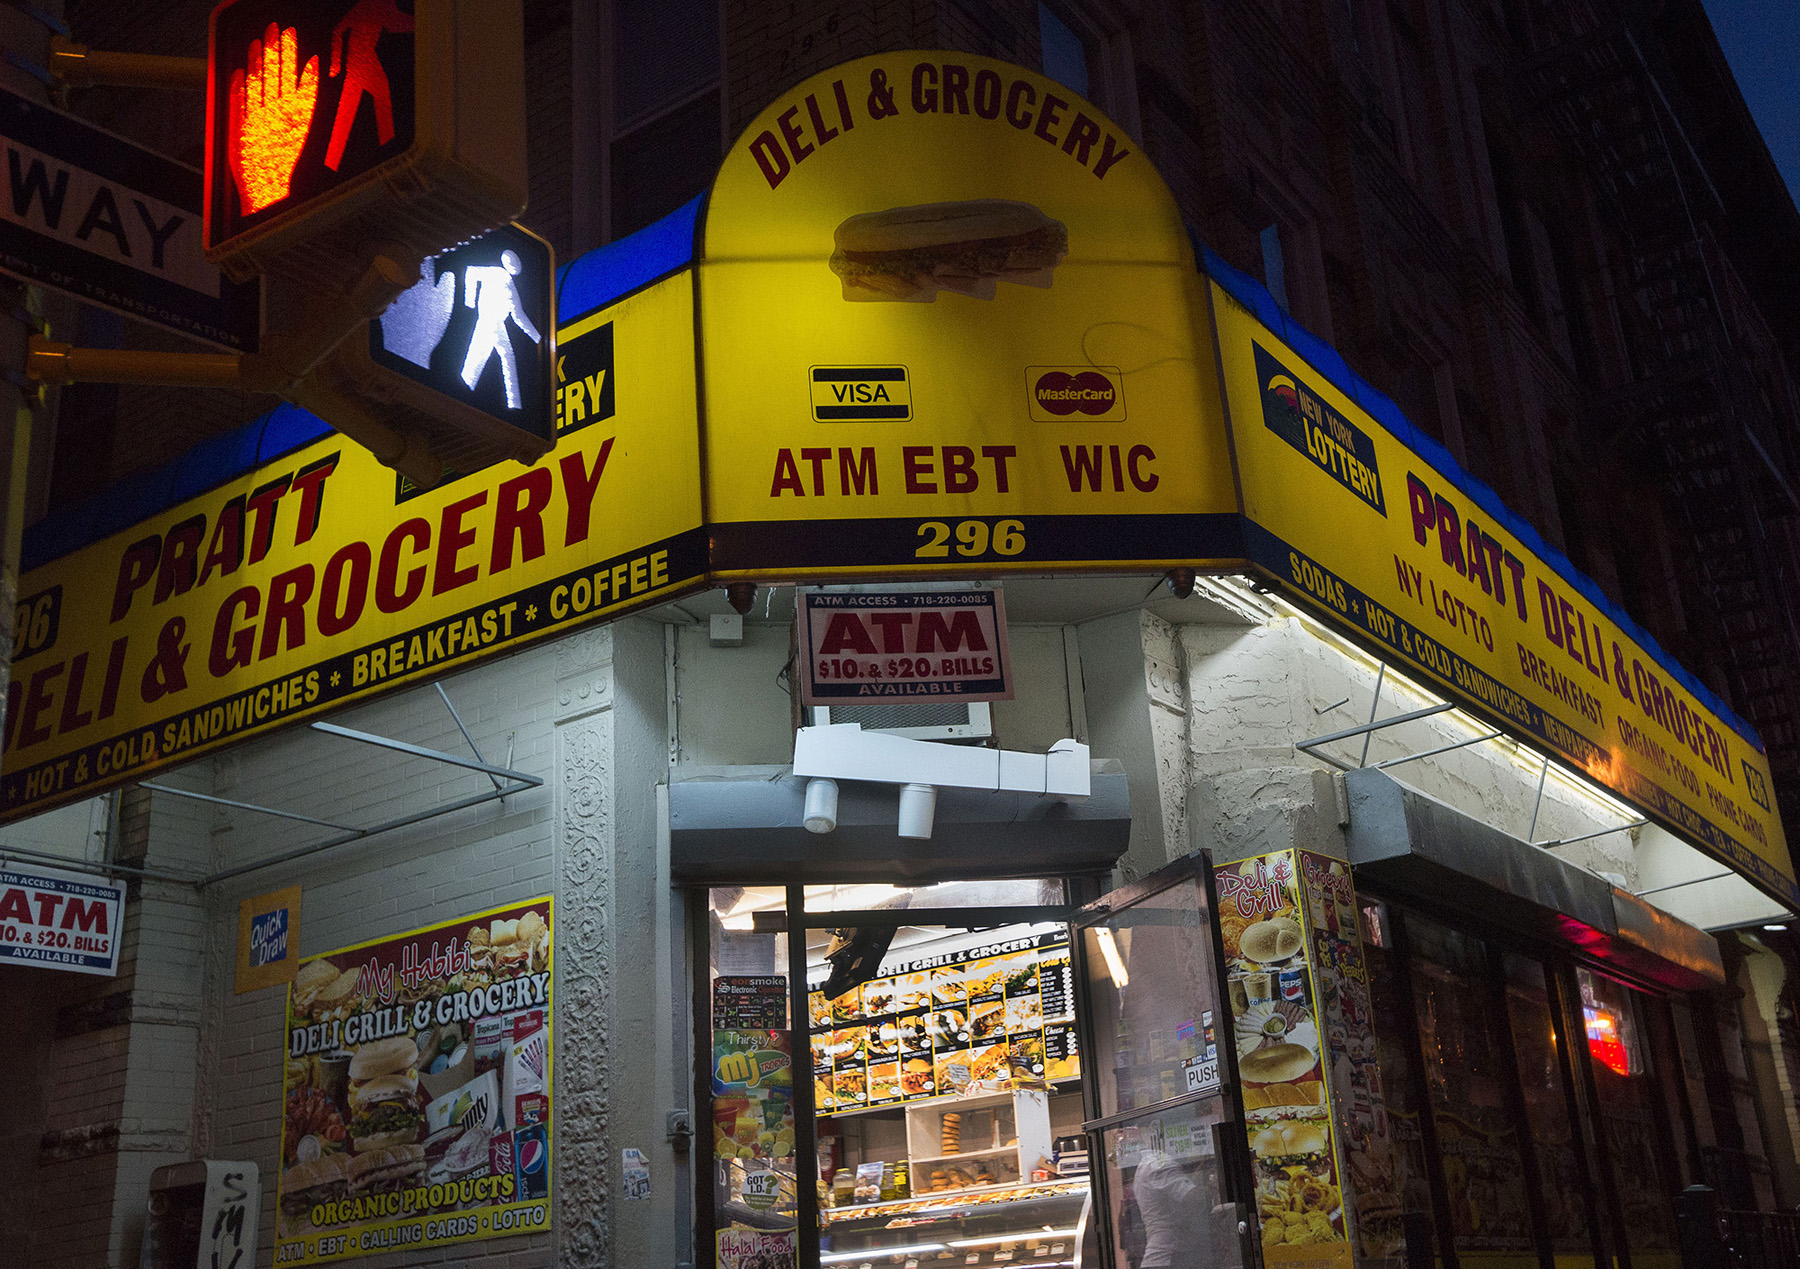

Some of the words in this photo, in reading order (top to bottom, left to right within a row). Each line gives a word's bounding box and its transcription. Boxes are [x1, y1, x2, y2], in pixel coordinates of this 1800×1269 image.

[749, 80, 855, 190] DELI
[867, 68, 900, 120] &
[912, 63, 1129, 180] GROCERY
[8, 147, 185, 269] WAY
[85, 281, 241, 345] TRANSPORTATION
[832, 382, 889, 405] VISA
[1038, 388, 1113, 400] MasterCard
[1298, 388, 1322, 425] NEW
[1326, 410, 1355, 454] YORK
[770, 447, 879, 498] ATM
[904, 445, 1016, 496] EBT
[1060, 444, 1159, 494] WIC
[1302, 417, 1379, 505] LOTTERY
[109, 450, 341, 625] PRATT
[916, 519, 1026, 558] 296
[141, 616, 191, 703] &
[208, 437, 615, 677] GROCERY
[815, 596, 844, 605] ATM
[848, 596, 897, 605] ACCESS
[913, 594, 987, 604] 718-220-0085
[13, 593, 53, 659] 96
[819, 611, 988, 654] ATM
[1290, 552, 1347, 613] SODAS
[1364, 599, 1396, 645] HOT
[1401, 624, 1413, 653] &
[1415, 631, 1451, 677] COLD
[1453, 658, 1531, 724] SANDWICHES
[1407, 470, 1528, 623] PRATT
[1537, 576, 1610, 685] DELI
[1612, 641, 1635, 705] &
[1633, 659, 1734, 785] GROCERY
[25, 759, 69, 801] HOT
[74, 754, 88, 783] &
[97, 730, 156, 777] COLD
[162, 669, 320, 754] SANDWICHES
[352, 603, 517, 688] BREAKFAST
[550, 549, 669, 620] COFFEE
[819, 658, 864, 679] $10.
[868, 663, 882, 679] &
[888, 657, 938, 678] $20.
[942, 656, 994, 676] BILLS
[859, 682, 962, 696] AVAILABLE
[1394, 554, 1424, 606] NY
[1429, 580, 1494, 653] LOTTO
[1516, 641, 1605, 730] BREAKFAST
[1618, 715, 1671, 776] ORGANIC
[1670, 753, 1701, 798] FOOD
[1706, 782, 1740, 826] PHONE
[1737, 806, 1768, 847] CARDS
[20, 877, 56, 889] ACCESS
[66, 884, 116, 898] 718-220-0085
[1216, 861, 1268, 897] Deli
[1273, 858, 1292, 888] &
[1303, 854, 1353, 904] Grocery
[0, 888, 108, 935] ATM
[1236, 882, 1284, 919] Grill
[0, 925, 19, 942] 10.
[23, 932, 33, 944] &
[38, 930, 71, 949] $20.
[74, 936, 108, 953] BILLS
[251, 909, 283, 950] Quick
[258, 930, 288, 967] Draw
[12, 947, 85, 965] AVAILABLE
[357, 956, 394, 1005] My
[401, 937, 472, 990] Habibi
[877, 959, 910, 978] DELI
[912, 953, 954, 972] GRILL
[957, 950, 967, 963] &
[969, 936, 1041, 959] GROCERY
[731, 985, 757, 994] Electronic
[1281, 978, 1303, 988] PEPS
[290, 1019, 340, 1058] DELI
[344, 1004, 409, 1046] GRILL
[412, 999, 432, 1031] &
[436, 971, 550, 1026] GROCERY
[476, 1023, 500, 1034] Tropicana
[728, 1031, 780, 1049] Thirsty?
[1188, 1064, 1220, 1087] PUSH
[311, 1191, 400, 1227] ORGANIC
[402, 1172, 515, 1213] PRODUCTS
[747, 1175, 764, 1186] GOT
[277, 1243, 305, 1262] ATM
[318, 1236, 347, 1256] EBT
[360, 1225, 422, 1250] CALLING
[426, 1215, 478, 1239] CARDS
[493, 1205, 546, 1230] LOTTO
[721, 1236, 755, 1259] Halal
[761, 1236, 793, 1254] Food
